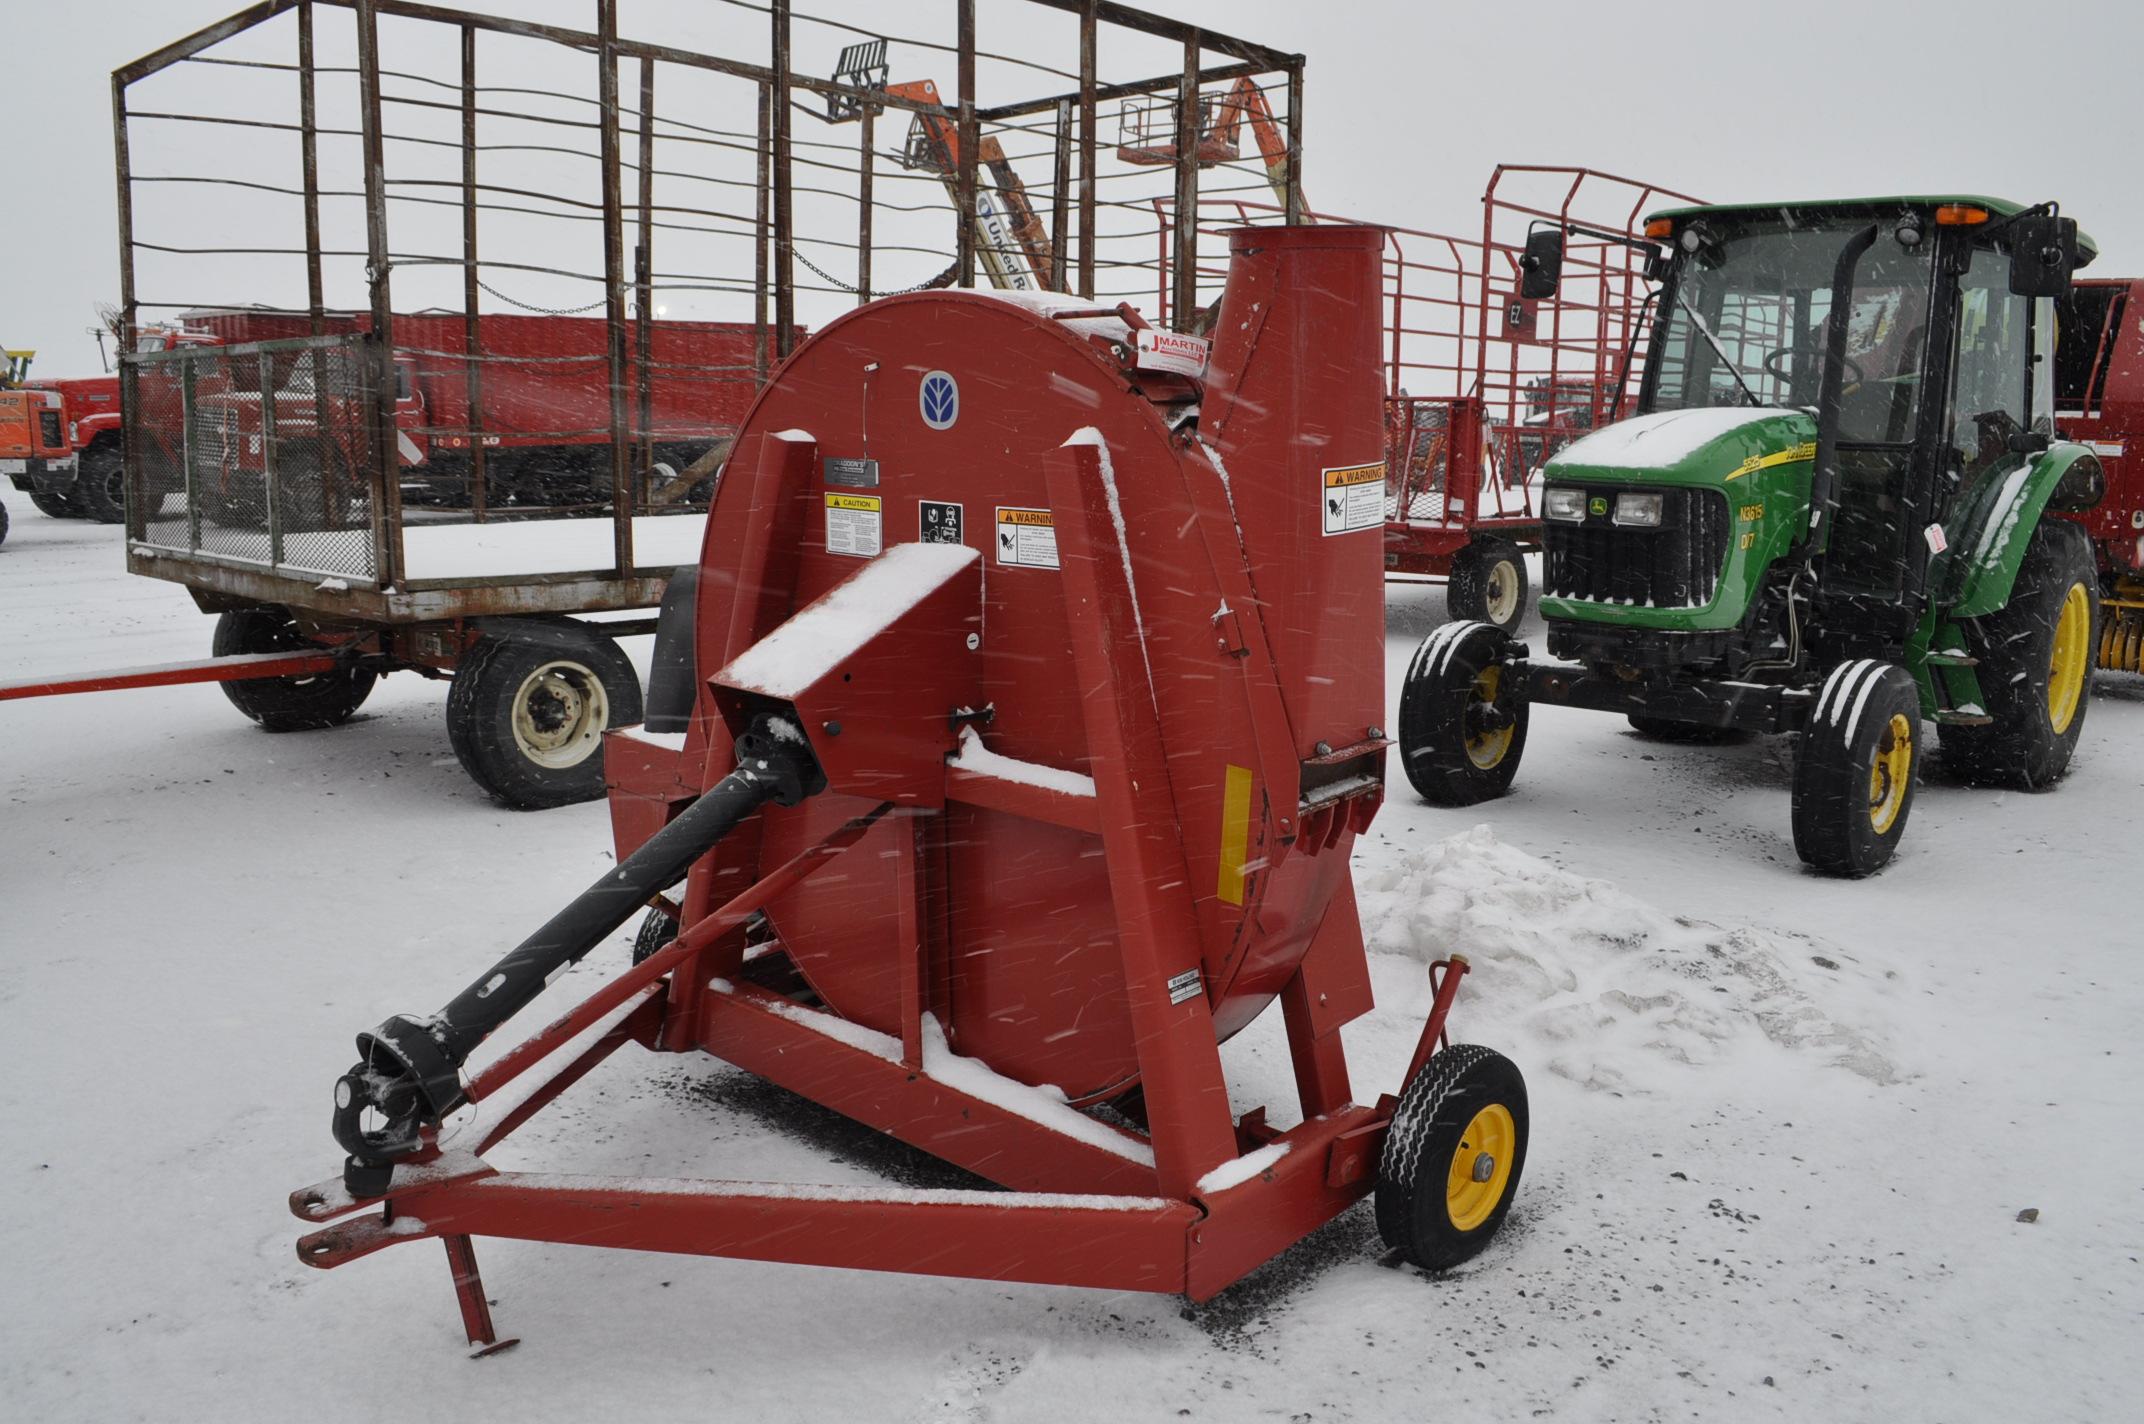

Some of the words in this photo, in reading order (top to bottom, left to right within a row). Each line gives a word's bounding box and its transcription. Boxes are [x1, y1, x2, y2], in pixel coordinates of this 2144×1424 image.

[1510, 305, 1521, 324] EZ
[1160, 337, 1206, 354] MARTIN
[1743, 455, 1760, 470] 5525
[1346, 468, 1382, 482] WARNING
[843, 499, 870, 508] CAUTION
[1016, 513, 1052, 524] WARNIN
